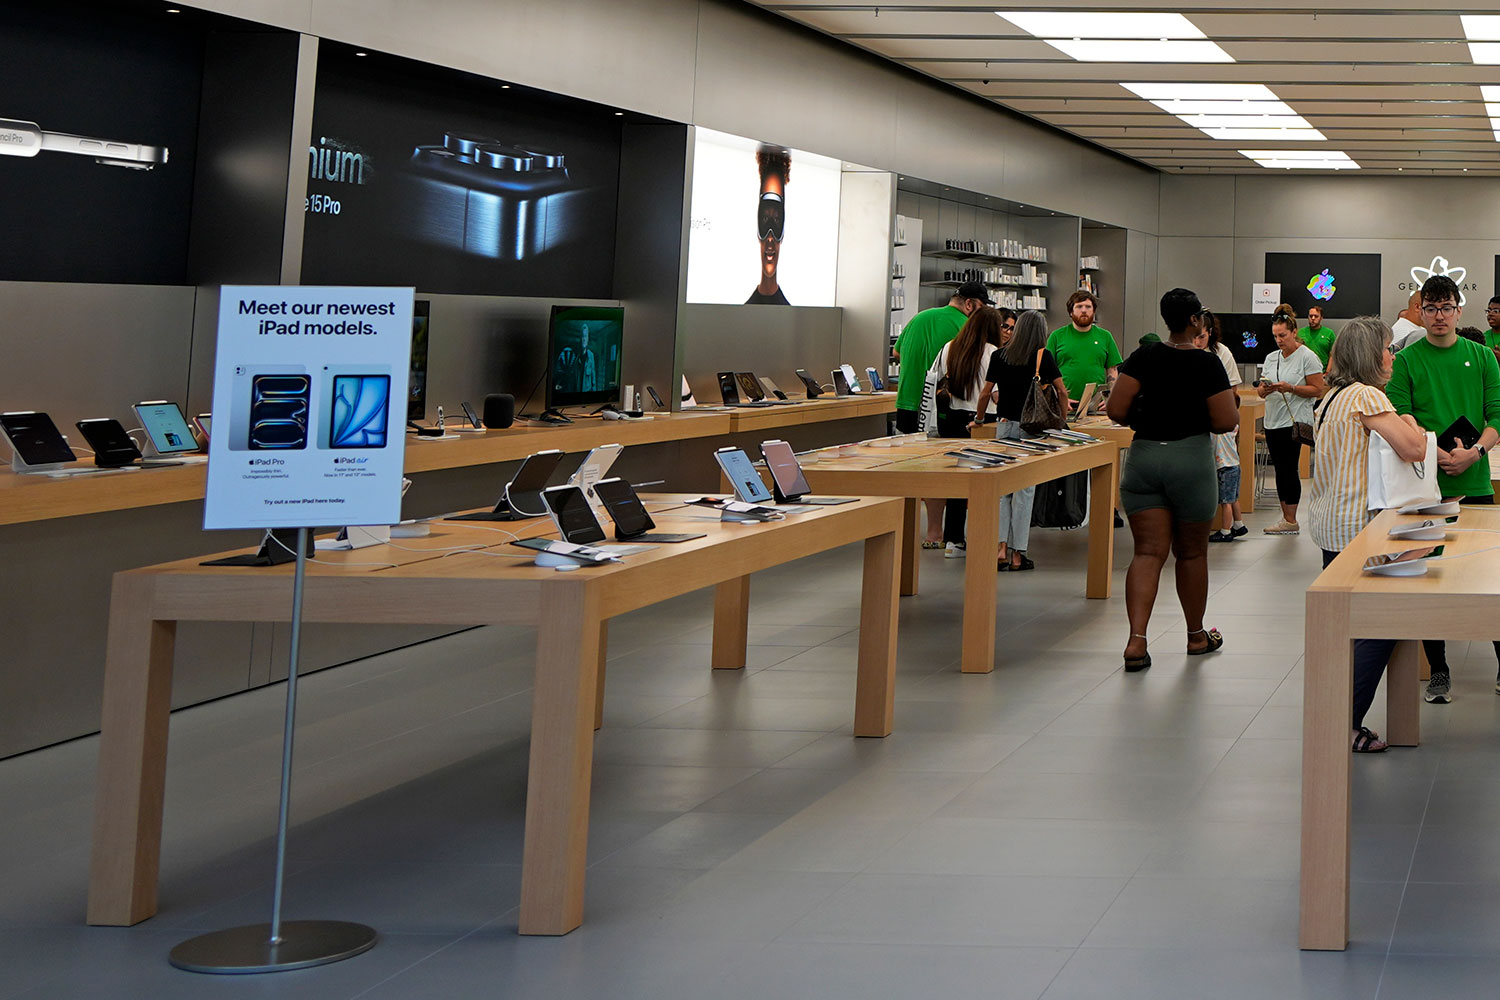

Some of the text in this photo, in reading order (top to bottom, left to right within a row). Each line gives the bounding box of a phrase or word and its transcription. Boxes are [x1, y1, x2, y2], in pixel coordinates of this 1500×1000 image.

[12, 133, 23, 143] Pro
[310, 194, 322, 212] 15
[323, 196, 341, 215] Pro
[239, 300, 396, 315] Meet our newest
[258, 320, 378, 335] iPad models.
